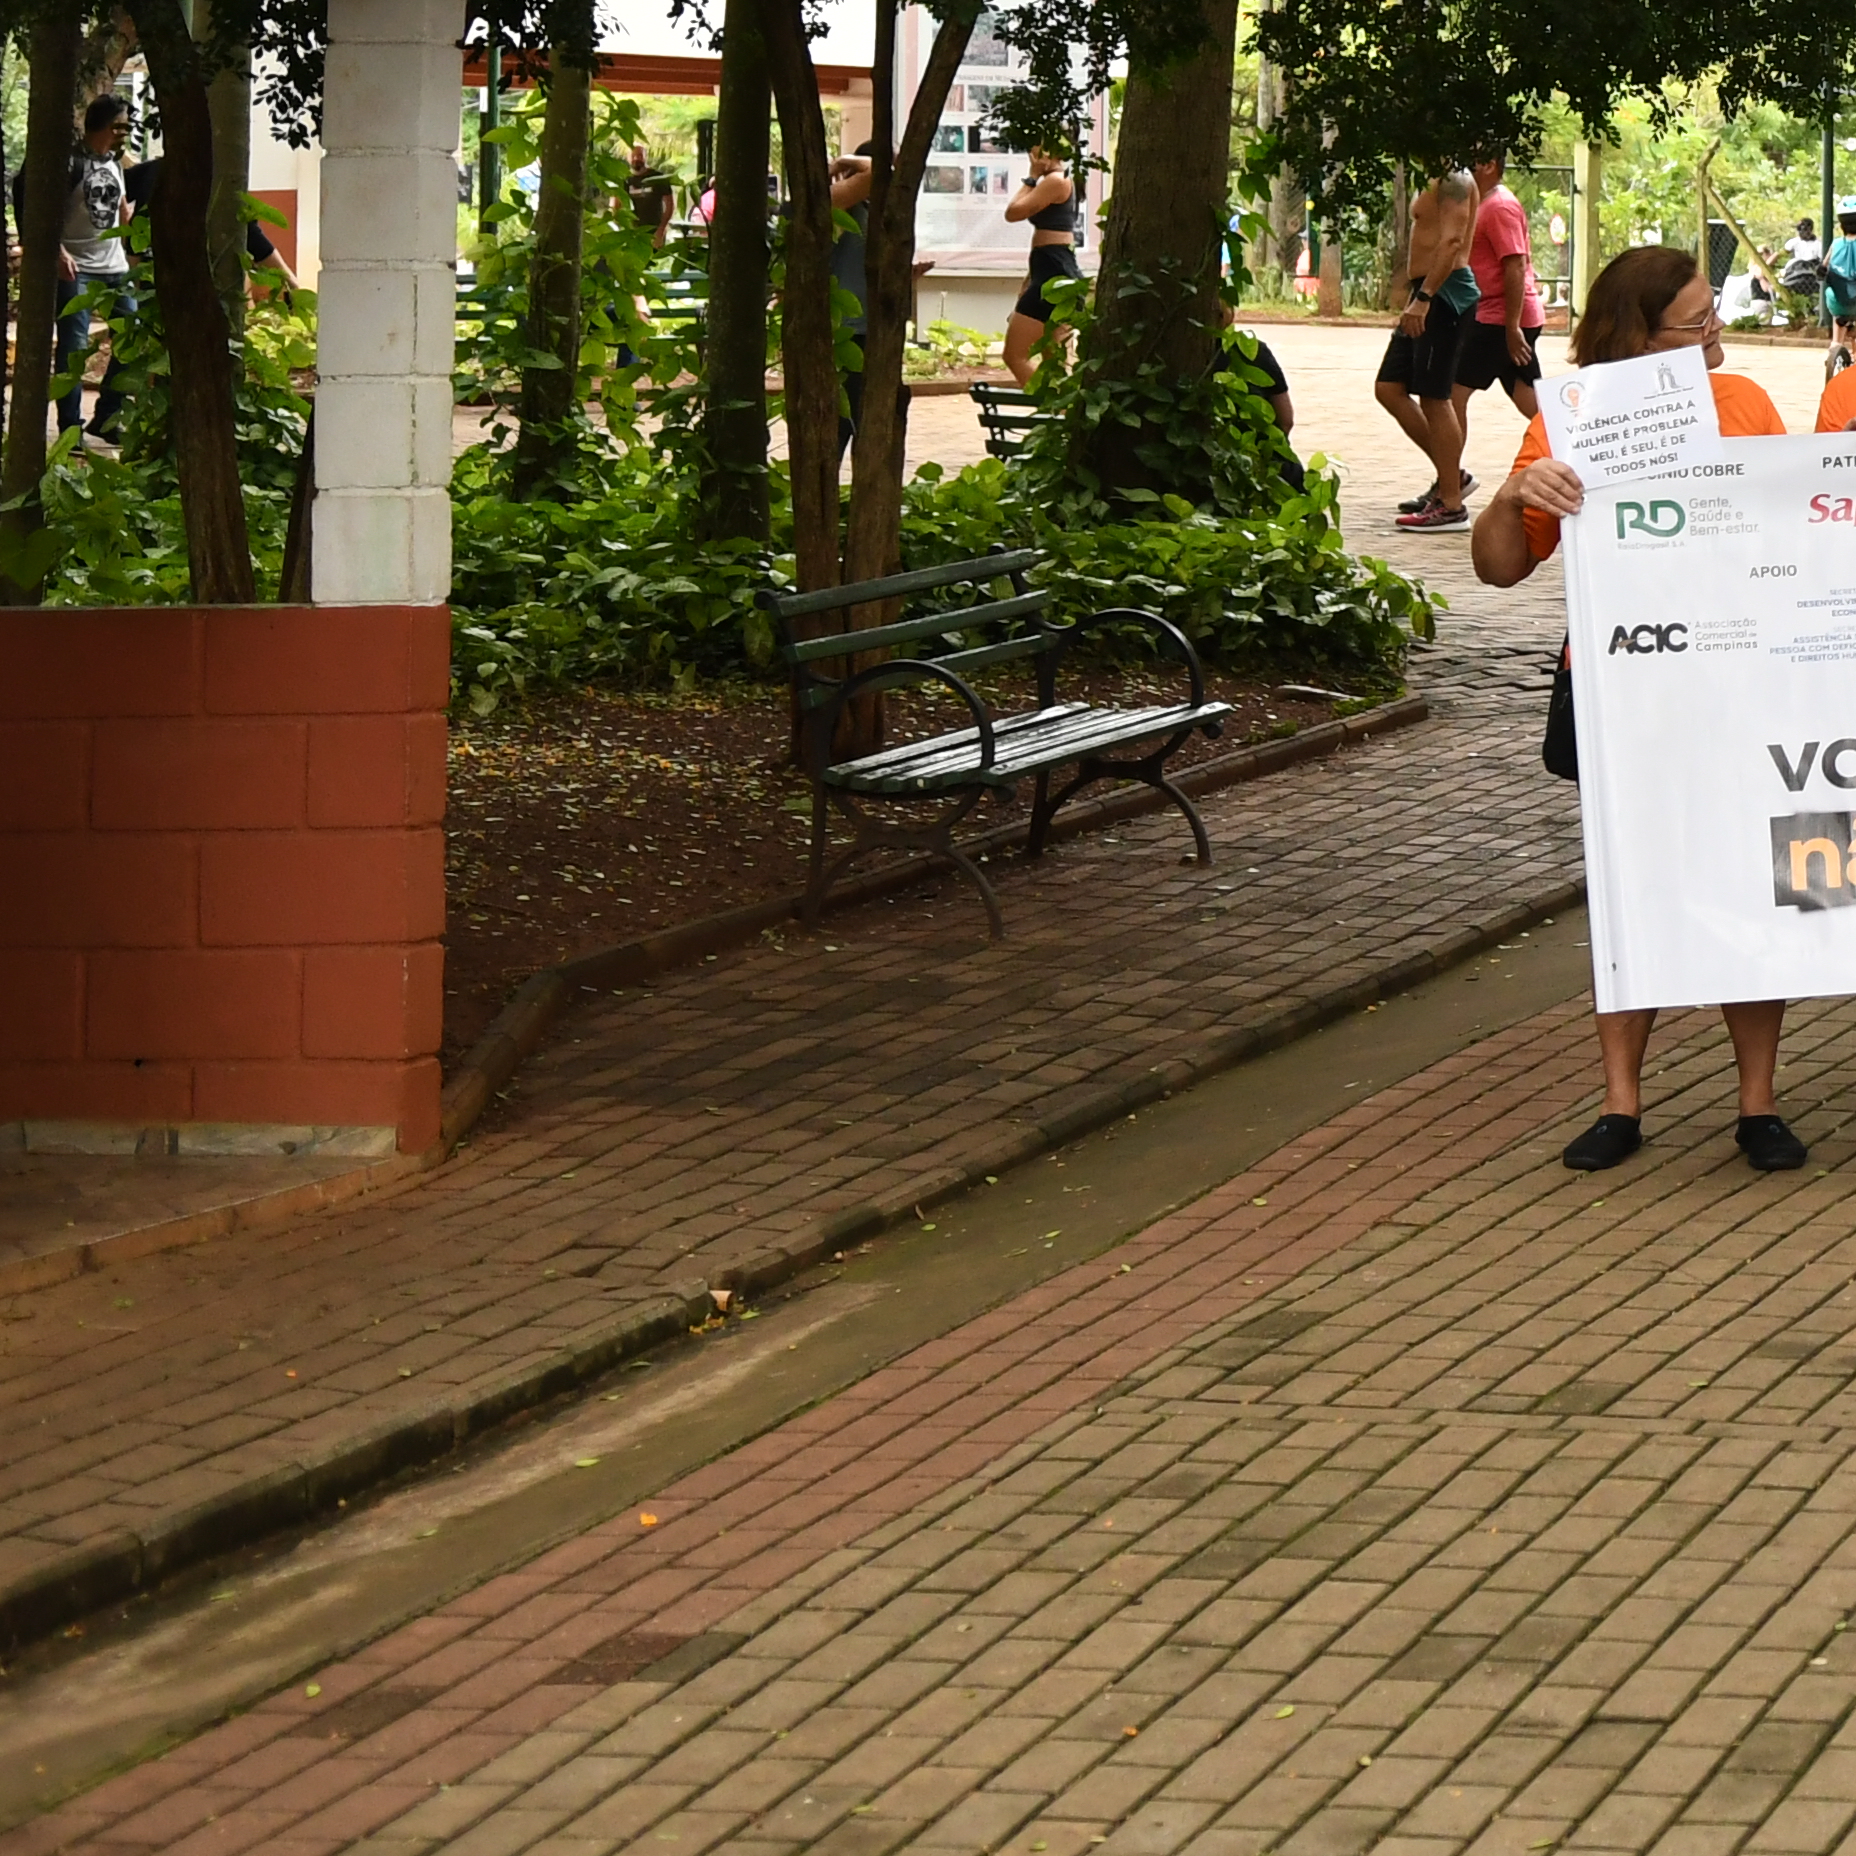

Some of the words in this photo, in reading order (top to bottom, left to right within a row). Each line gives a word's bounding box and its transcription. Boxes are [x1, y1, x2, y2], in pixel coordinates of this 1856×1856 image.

[1566, 413, 1631, 435] VIOLÊNCIA
[1633, 403, 1683, 420] CONTRA
[1687, 400, 1696, 409] A
[1572, 432, 1620, 450] MULHER
[1623, 428, 1630, 440] É
[1633, 415, 1699, 437] PROBLEMA
[1621, 445, 1628, 456] É
[1661, 436, 1667, 448] É
[1671, 434, 1687, 446] DE
[1604, 459, 1647, 476] TODOS
[1649, 452, 1679, 468] NÓS!
[1692, 464, 1745, 478] COBRE
[1689, 497, 1733, 510] Gente,
[1616, 499, 1686, 540] RD
[1690, 508, 1732, 522] Saúde
[1736, 511, 1744, 520] e
[1750, 564, 1798, 579] APOIO
[1694, 618, 1757, 630] Associação
[1608, 622, 1689, 655] ACIC
[1694, 630, 1748, 640] Comercial
[1793, 632, 1852, 644] ASSISTÊNCIA
[1696, 640, 1758, 652] Campinas
[1770, 645, 1806, 654] PESSOA
[1808, 644, 1830, 652] COM
[1798, 652, 1840, 662] DIREITOS
